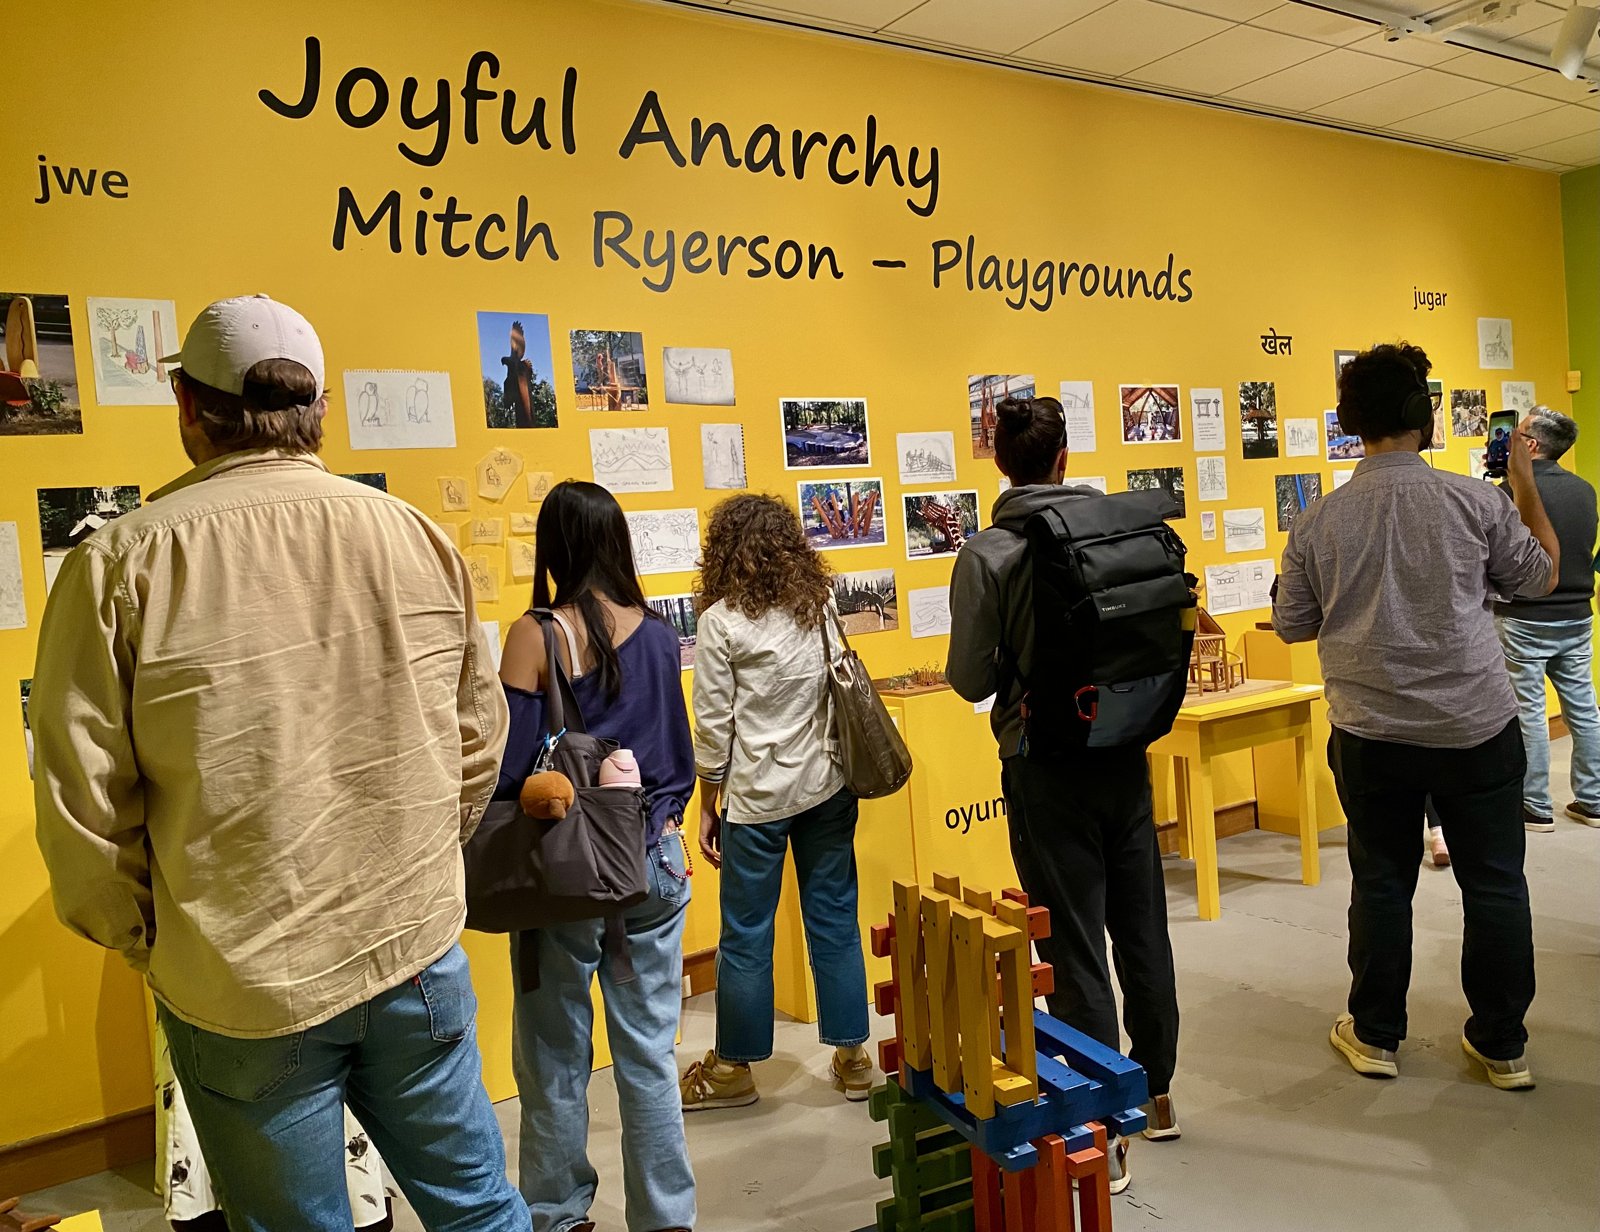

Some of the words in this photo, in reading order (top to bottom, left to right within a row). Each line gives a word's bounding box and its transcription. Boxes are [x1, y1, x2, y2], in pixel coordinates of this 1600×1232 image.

[258, 36, 579, 167] Joyful
[618, 90, 941, 218] Anarchy
[34, 154, 130, 205] jwe
[332, 186, 560, 262] Mitch
[593, 210, 845, 293] Ryerson
[931, 234, 1194, 312] Playgrounds
[1412, 286, 1448, 312] jugar
[1260, 327, 1293, 356] खेल
[945, 796, 1007, 835] oyun
